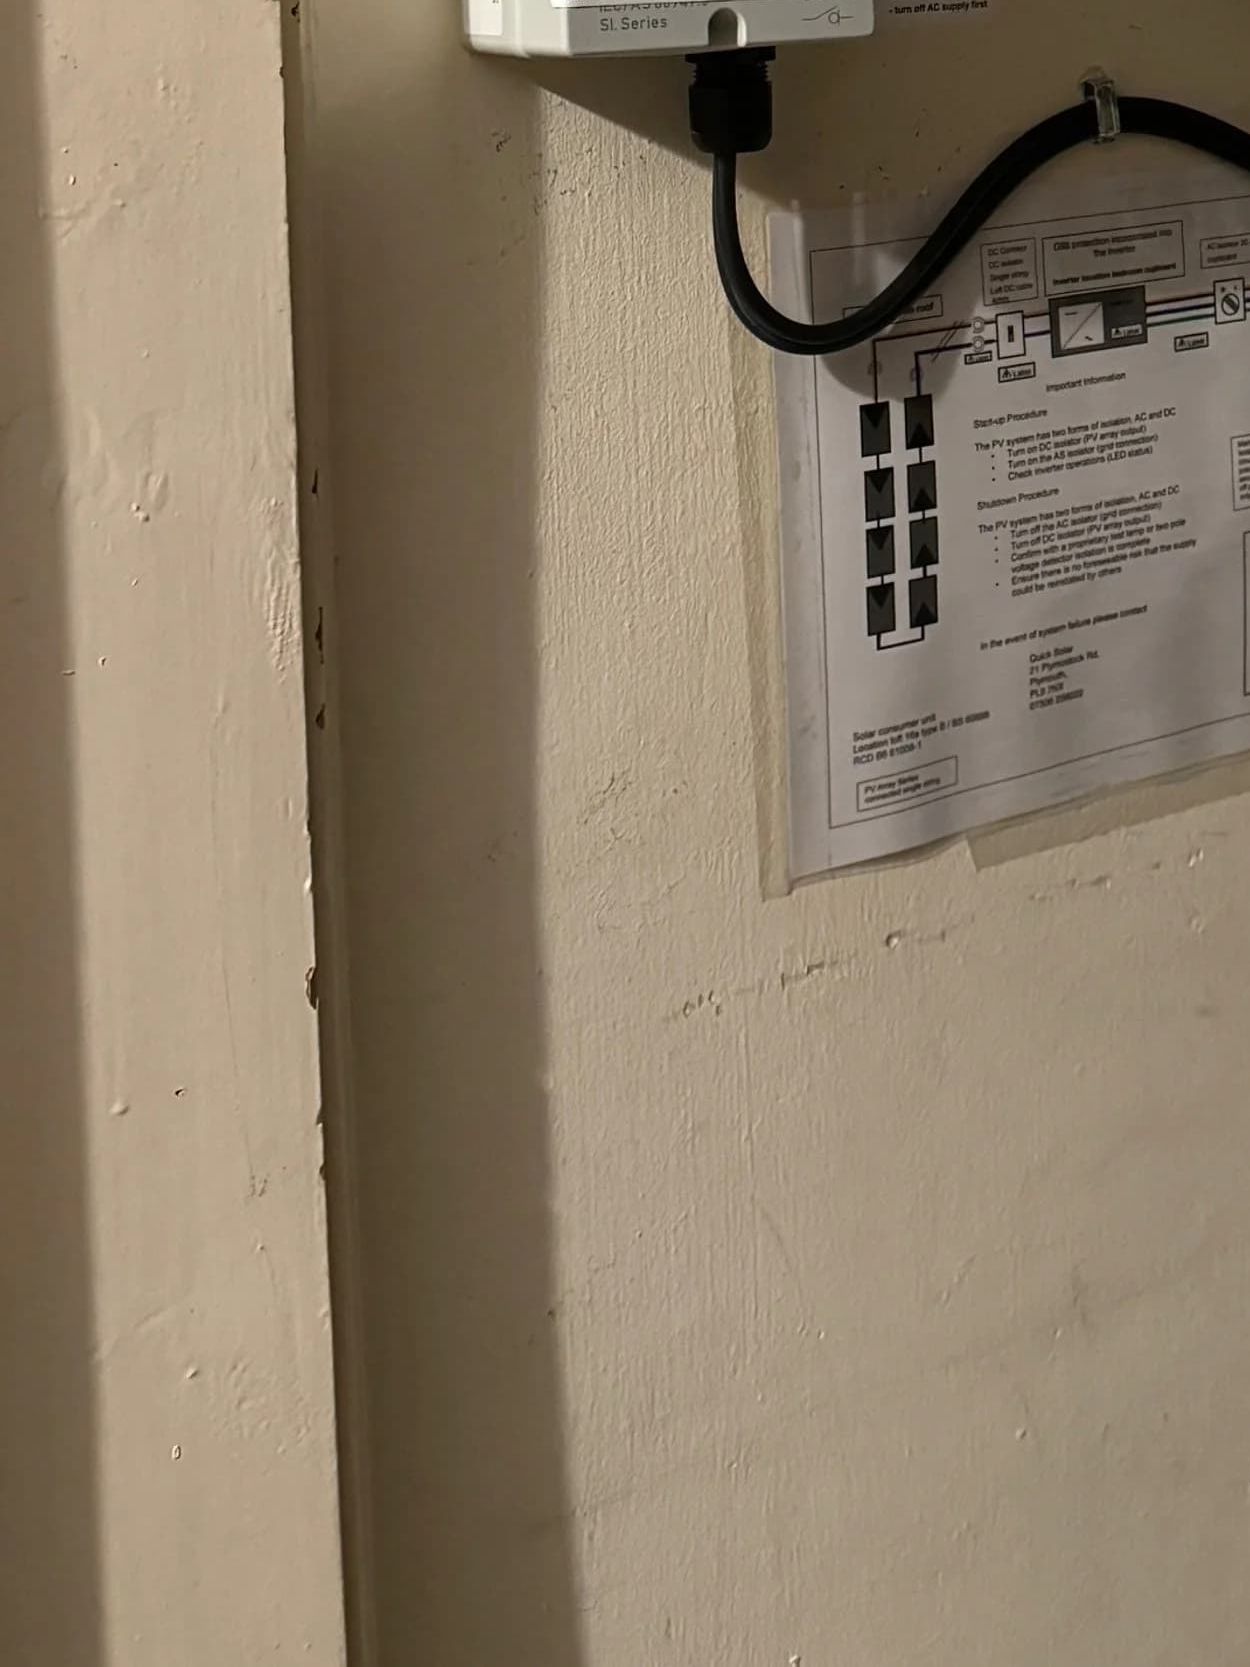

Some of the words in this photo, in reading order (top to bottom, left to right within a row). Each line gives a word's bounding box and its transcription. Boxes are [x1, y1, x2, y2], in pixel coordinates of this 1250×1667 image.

[894, 5, 912, 15] turn
[914, 3, 926, 13] off
[927, 3, 940, 12] AC
[942, 1, 970, 13] supply
[971, 0, 988, 9] first
[621, 15, 668, 31] Series
[973, 415, 1006, 430] Start-up
[1006, 408, 1048, 423] Procedure
[974, 441, 990, 453] The
[992, 438, 1006, 451] PV
[1006, 434, 1035, 448] system
[1134, 411, 1148, 423] AC
[1163, 406, 1177, 418] DC
[1007, 445, 1026, 458] Turn
[1038, 440, 1052, 452] DC
[1008, 457, 1027, 470] Turn
[1007, 468, 1033, 482] Check
[1017, 487, 1060, 503] Procedure
